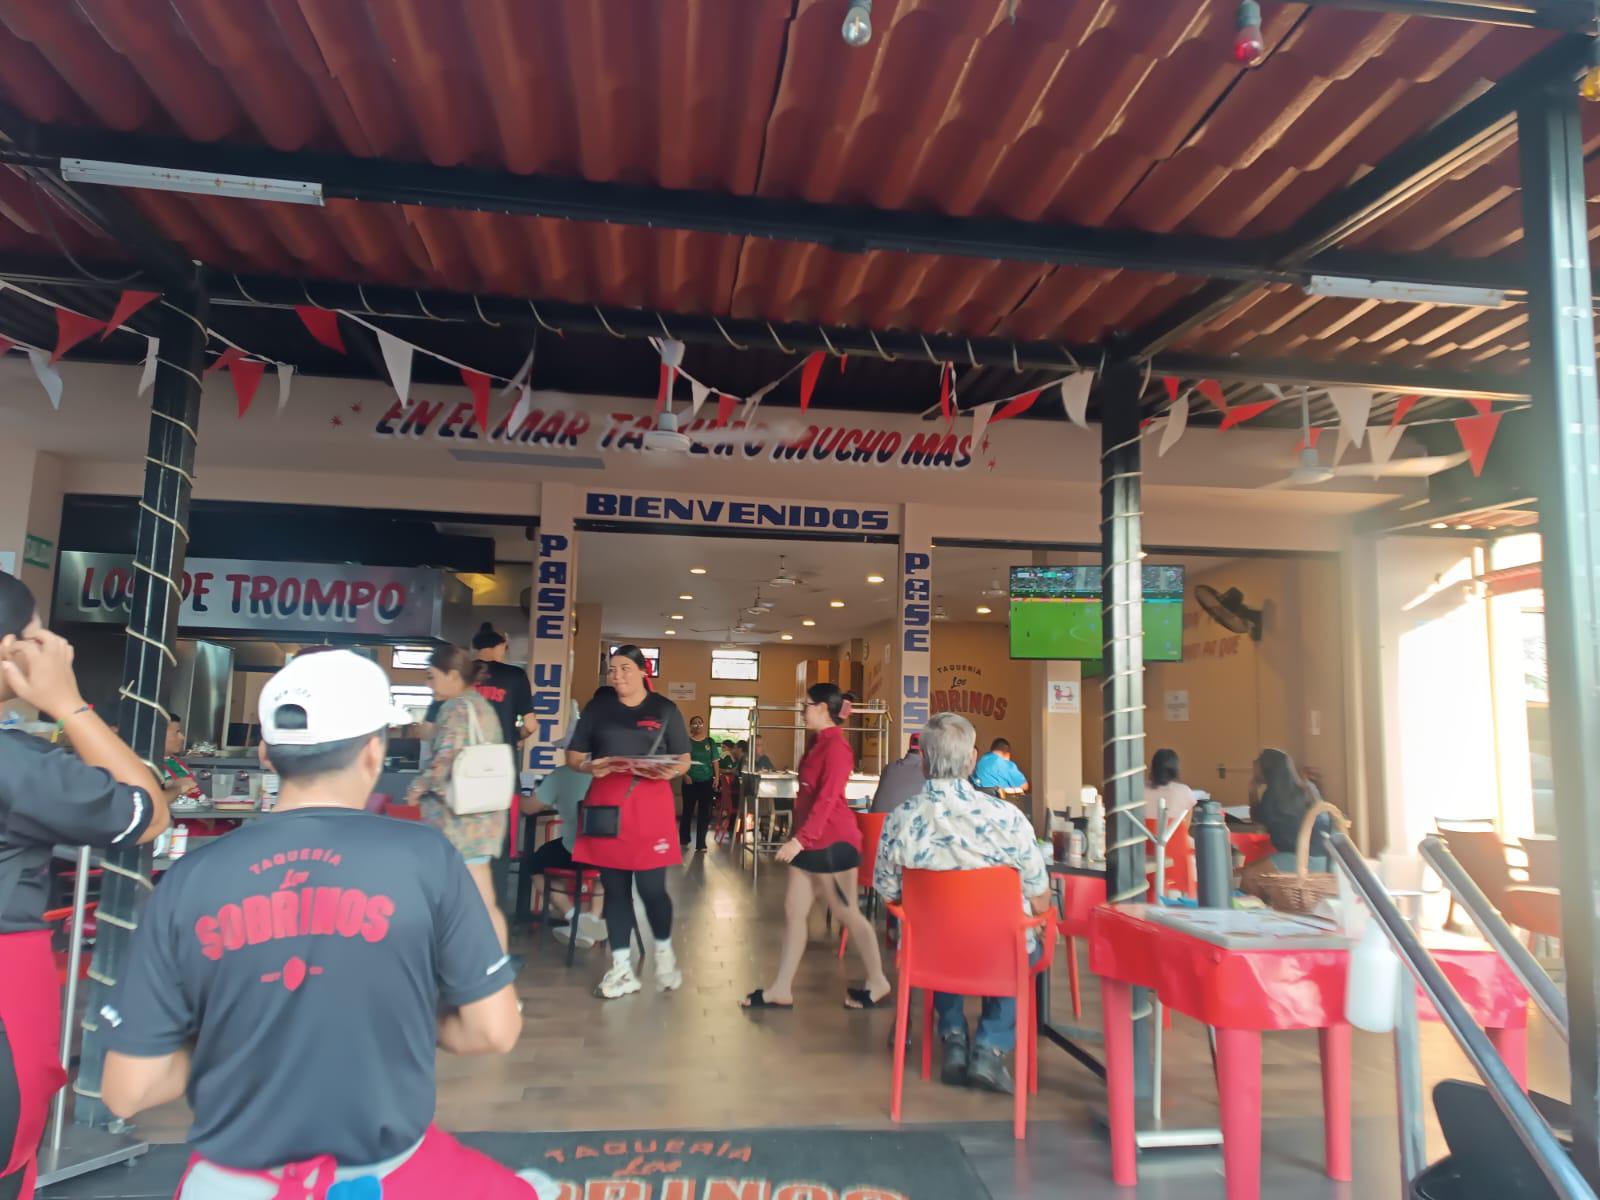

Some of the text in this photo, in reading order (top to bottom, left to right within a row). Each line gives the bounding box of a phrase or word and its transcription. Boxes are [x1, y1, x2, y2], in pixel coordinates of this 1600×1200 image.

[374, 398, 444, 438] EN
[437, 402, 479, 440] EL
[490, 408, 592, 448] MAR
[772, 423, 903, 463] MUCHO
[901, 431, 973, 468] MAS
[585, 492, 889, 531] BIENVENIDOS
[225, 574, 407, 621] TROMPO
[536, 534, 568, 640] PASE
[902, 552, 930, 734] PASE US
[195, 886, 395, 961] SOBRINOS
